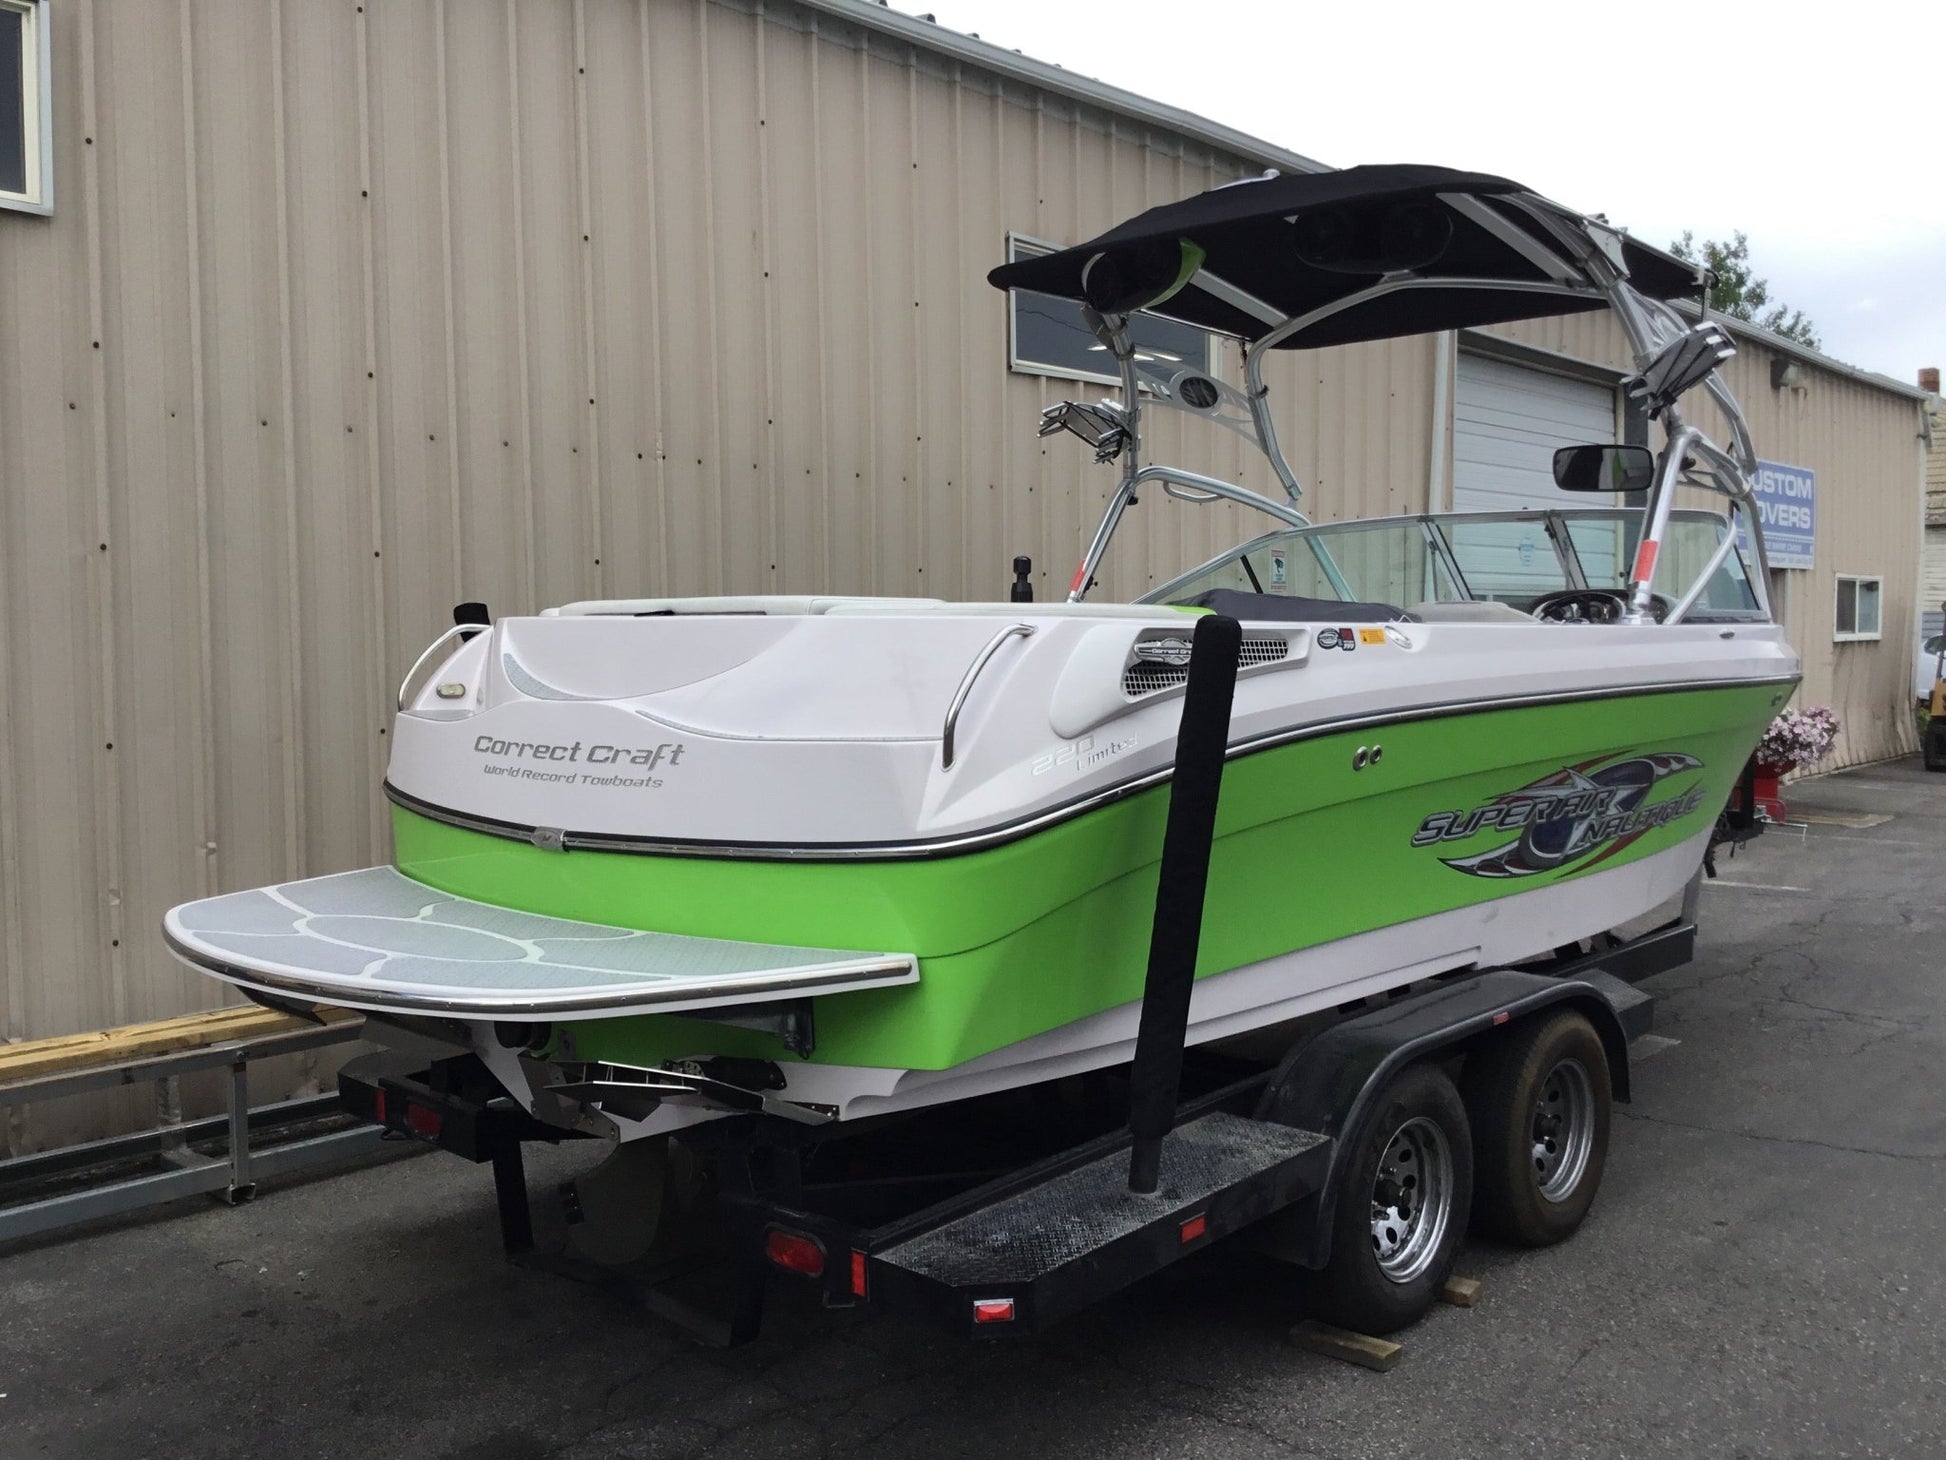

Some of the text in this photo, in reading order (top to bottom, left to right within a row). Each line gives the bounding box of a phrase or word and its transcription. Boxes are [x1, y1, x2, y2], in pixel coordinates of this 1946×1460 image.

[1751, 470, 1812, 499] USTOM
[1757, 501, 1811, 529] OVERS
[474, 735, 685, 772] Correct Craft
[1031, 732, 1138, 776] 220 Limited
[484, 764, 663, 788] World Record Towboats
